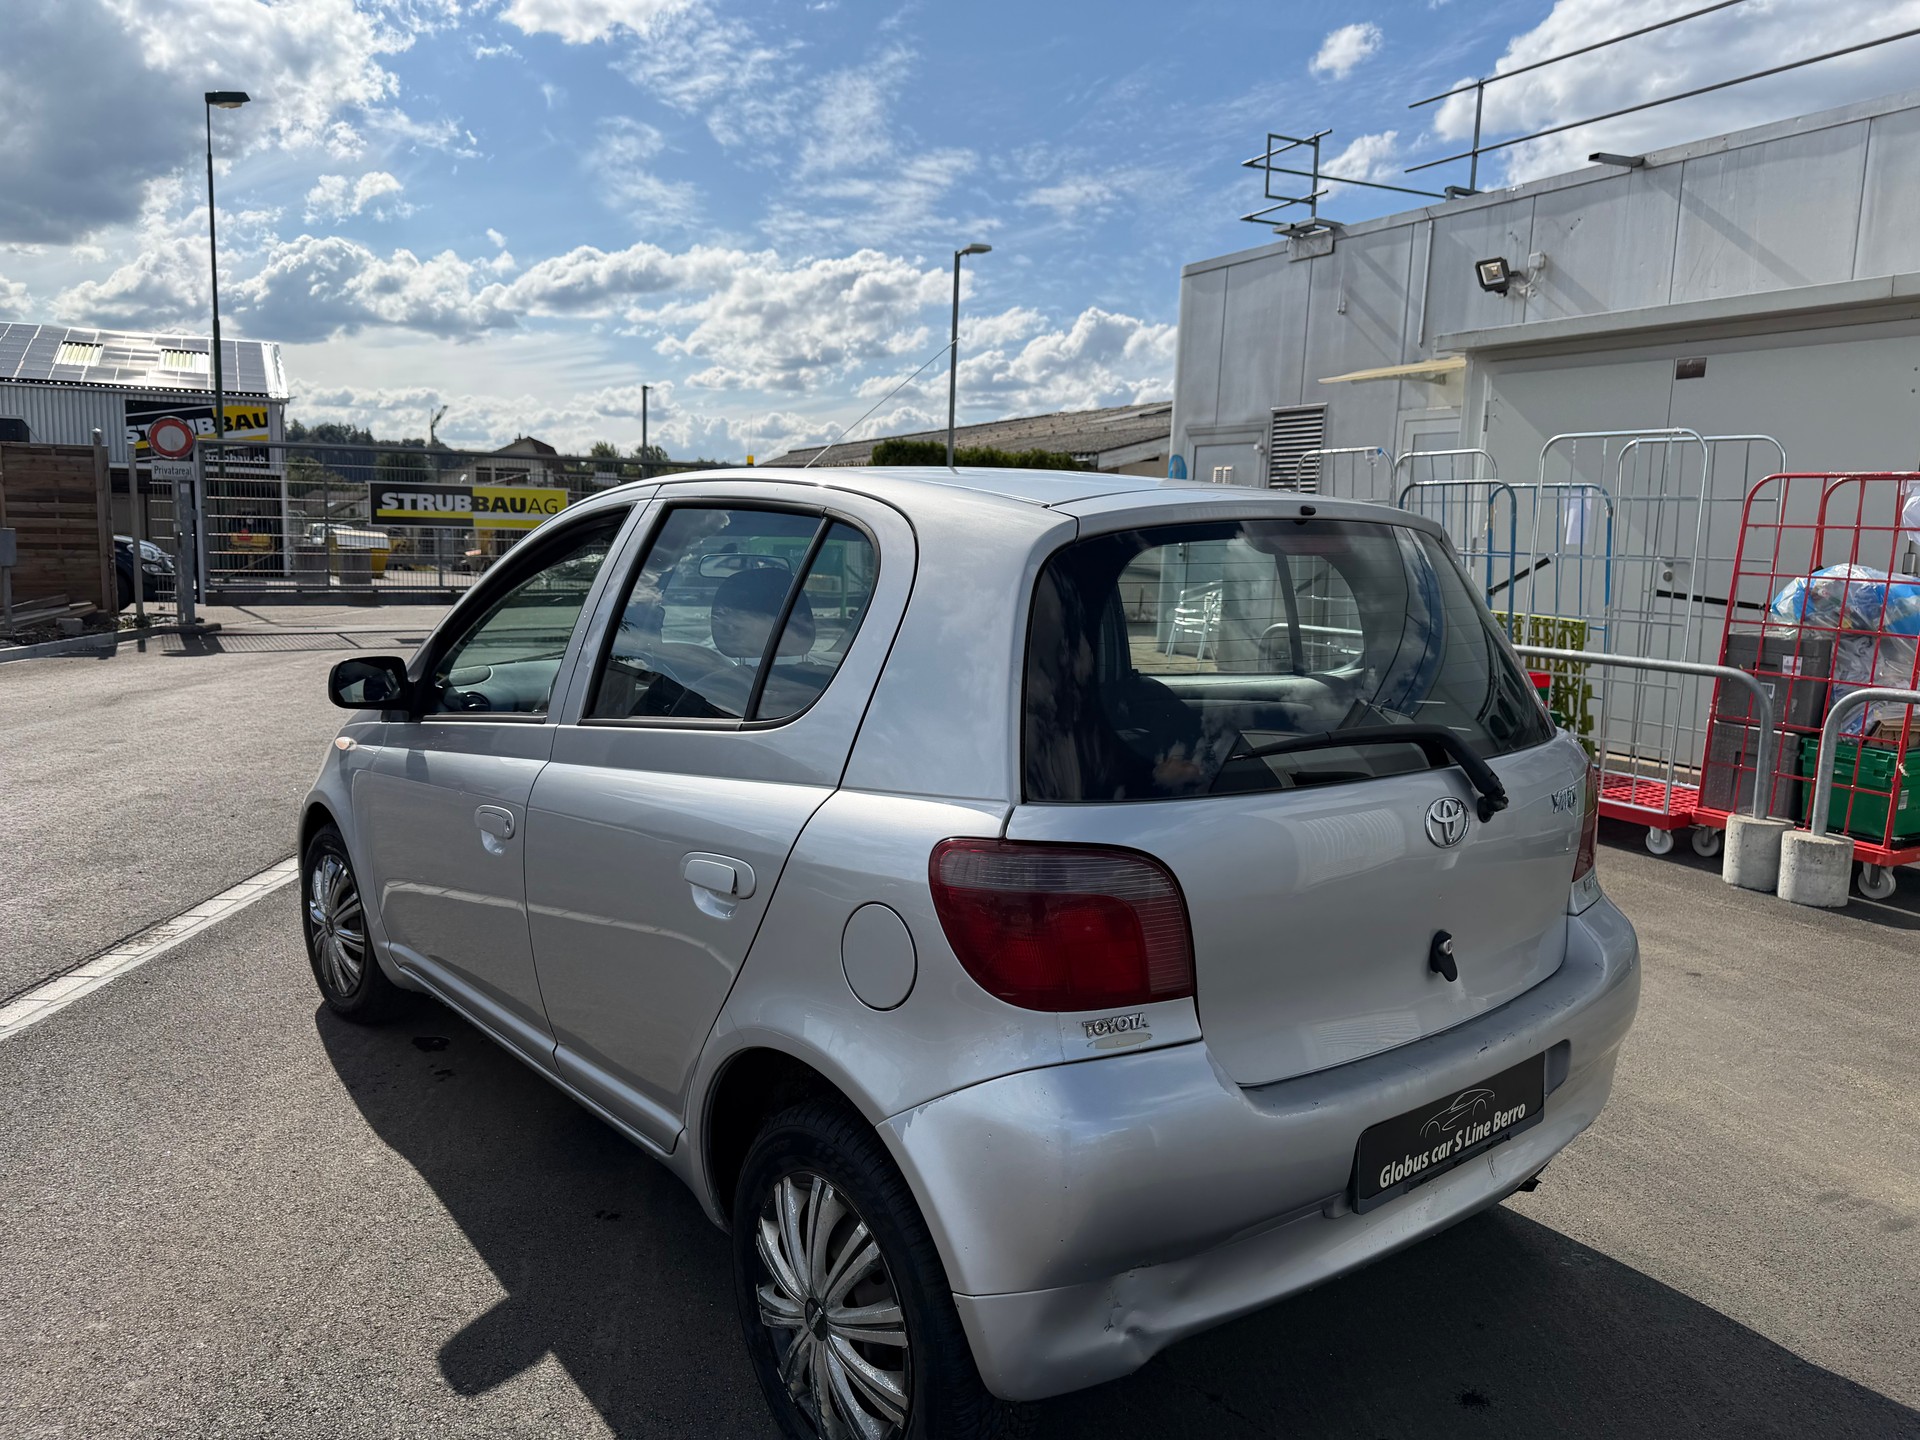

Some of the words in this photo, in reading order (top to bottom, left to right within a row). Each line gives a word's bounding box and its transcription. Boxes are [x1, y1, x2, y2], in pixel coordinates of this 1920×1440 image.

[154, 465, 192, 477] Privatareal
[1082, 1012, 1150, 1039] TOYOTA
[1379, 1150, 1429, 1188] Globus
[1431, 1139, 1454, 1163] car
[1454, 1129, 1463, 1153] S
[1465, 1122, 1490, 1148] Line
[1493, 1103, 1526, 1133] Berro
